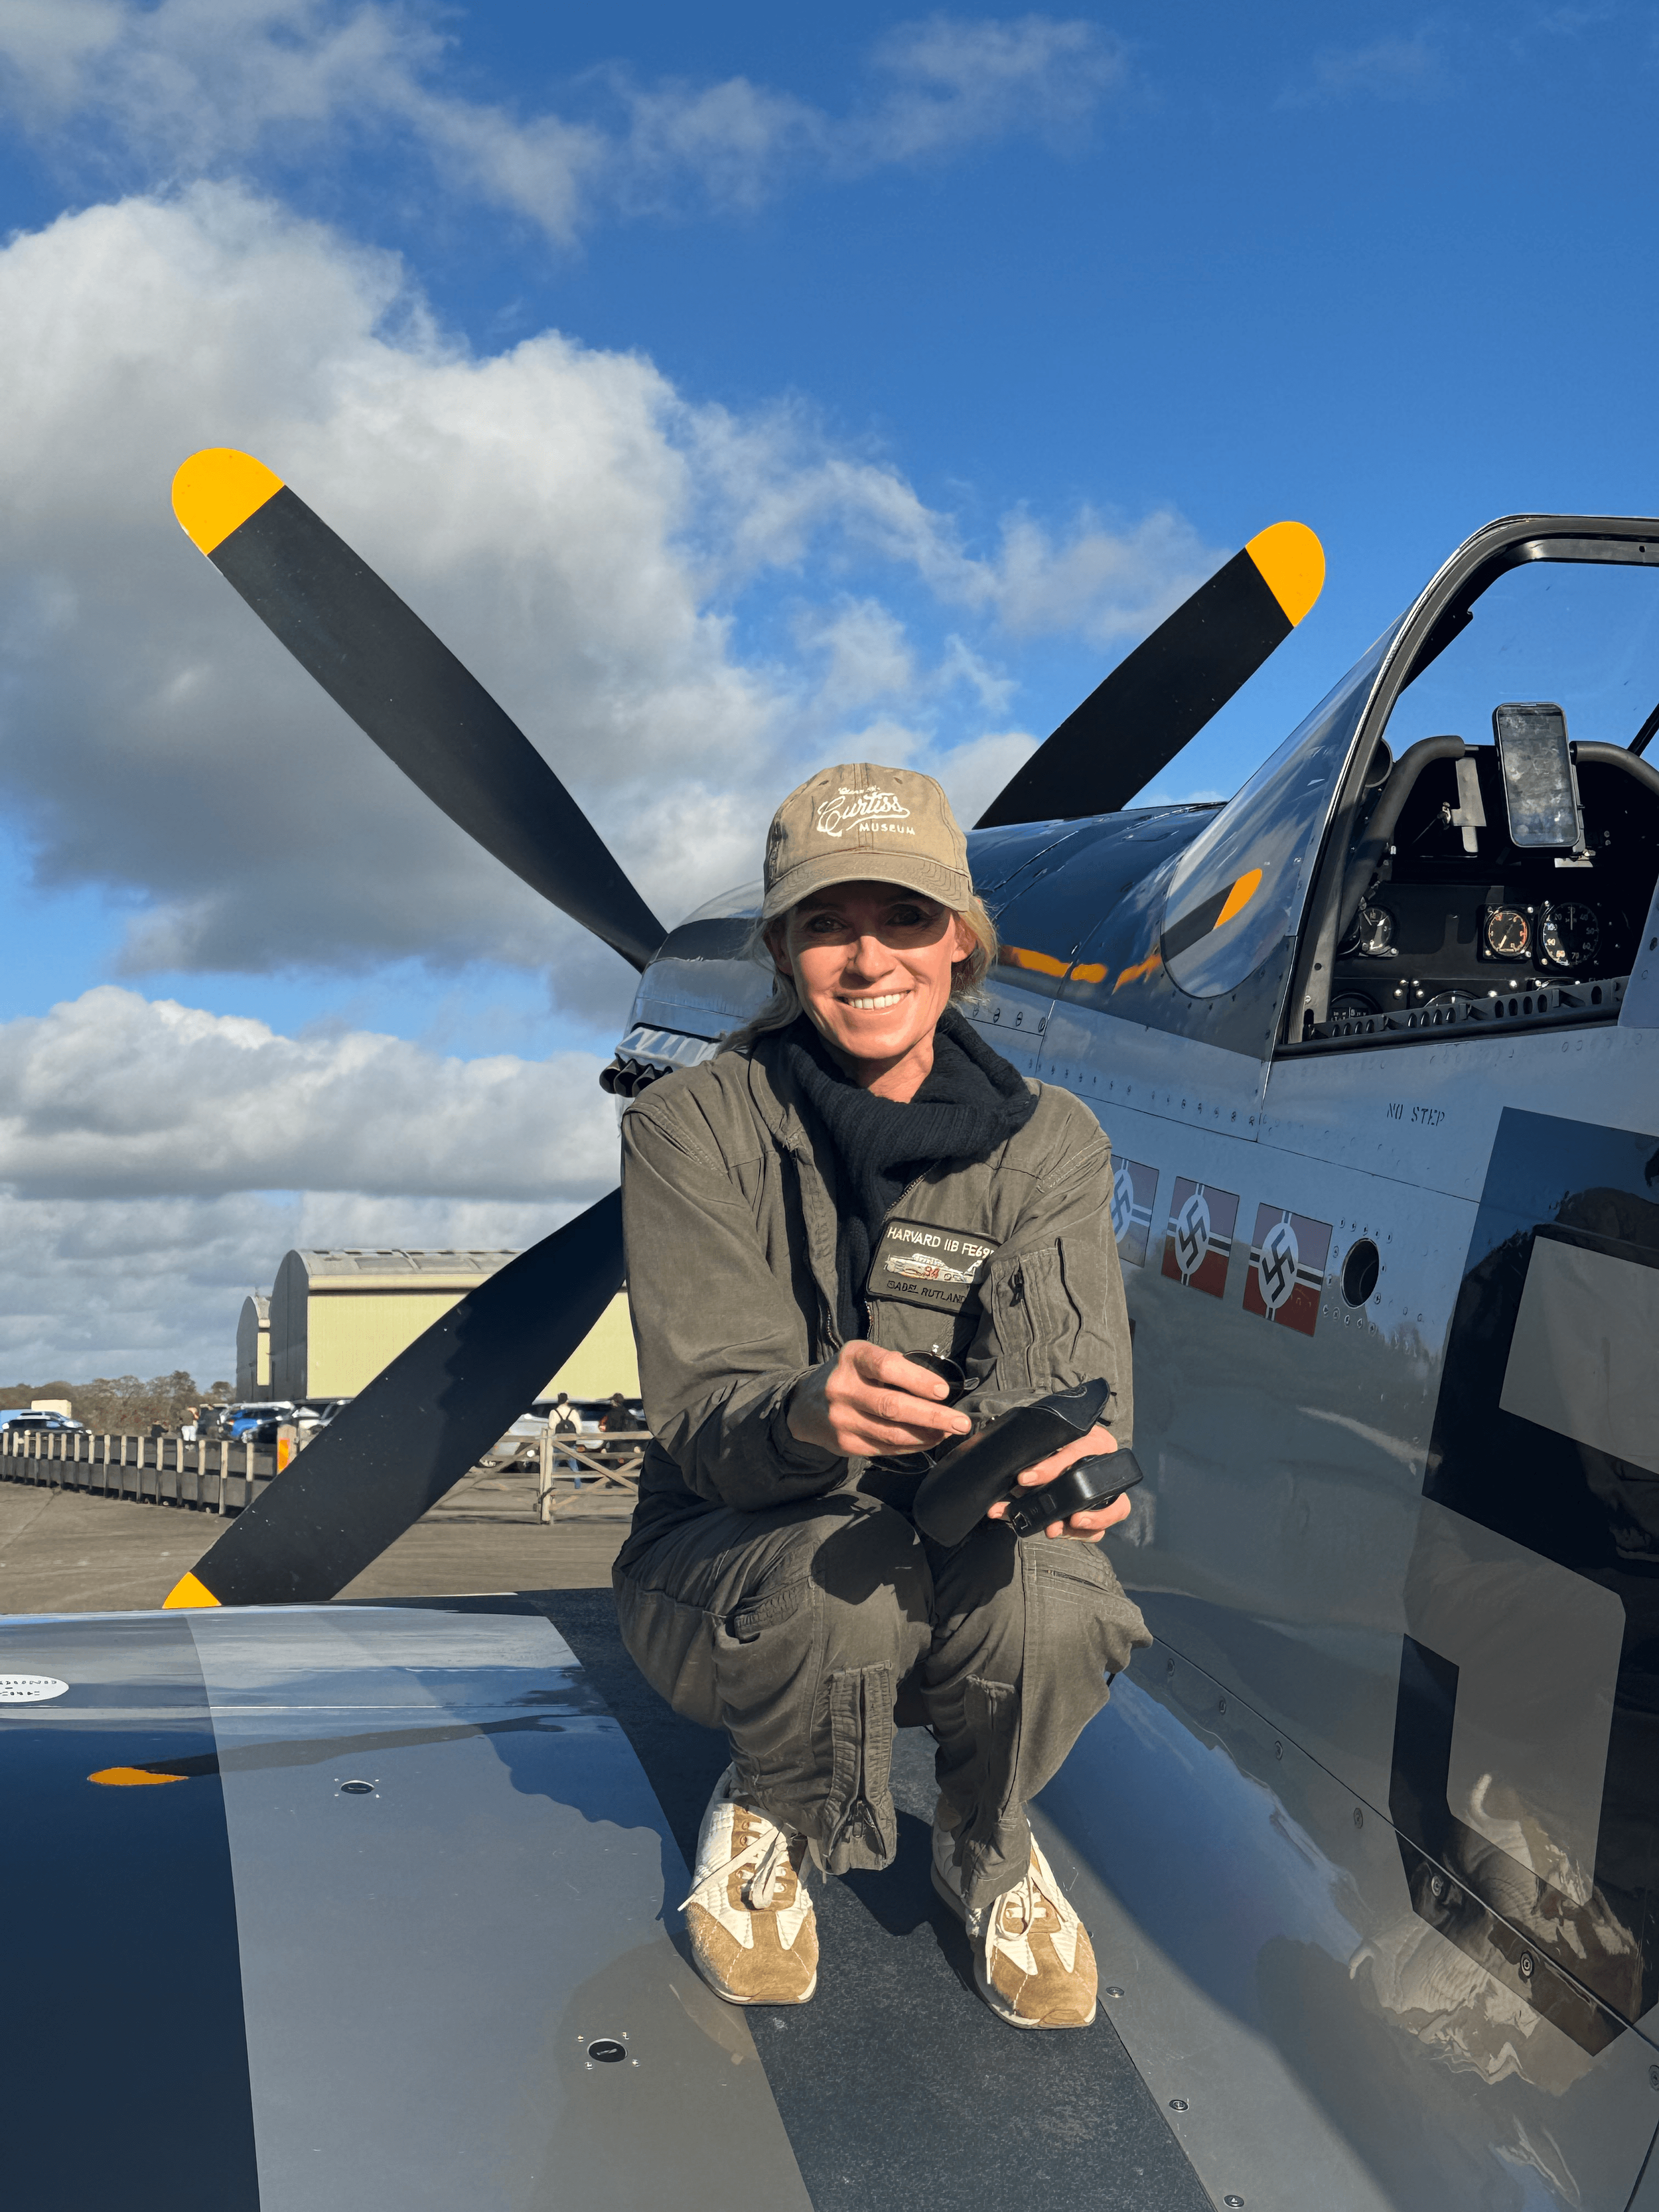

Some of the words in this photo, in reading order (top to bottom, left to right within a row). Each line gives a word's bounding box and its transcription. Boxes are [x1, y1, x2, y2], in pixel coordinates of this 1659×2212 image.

[817, 792, 910, 838] Curtiss
[859, 823, 916, 836] MUSEUM
[1387, 1103, 1403, 1120] NO
[1411, 1106, 1445, 1126] STEP
[887, 1226, 941, 1248] HARVARD
[944, 1238, 960, 1252] IIB
